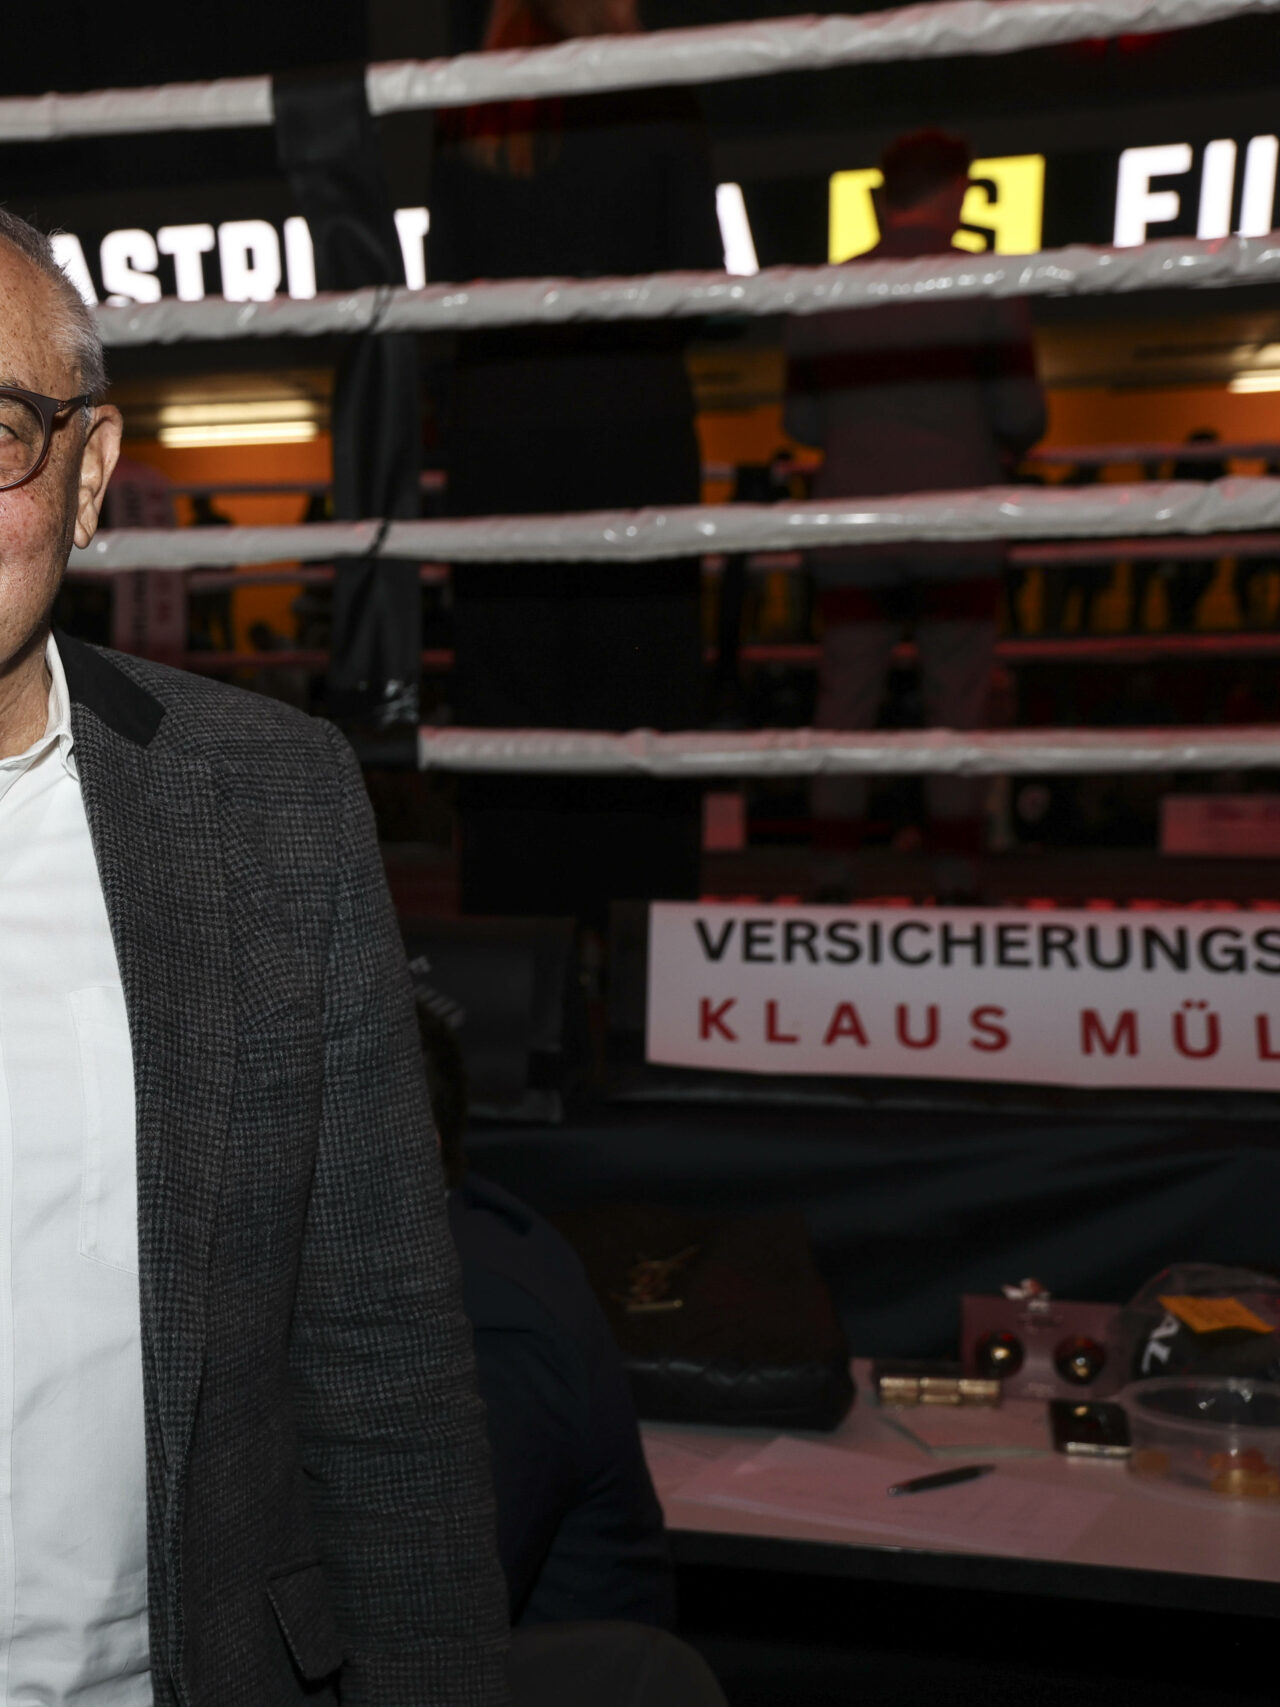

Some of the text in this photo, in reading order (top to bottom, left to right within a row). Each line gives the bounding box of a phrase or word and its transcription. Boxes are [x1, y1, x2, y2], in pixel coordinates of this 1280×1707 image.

[694, 919, 1280, 974] VERSICHERUNGS
[698, 997, 1280, 1061] KLAUS MÜL
